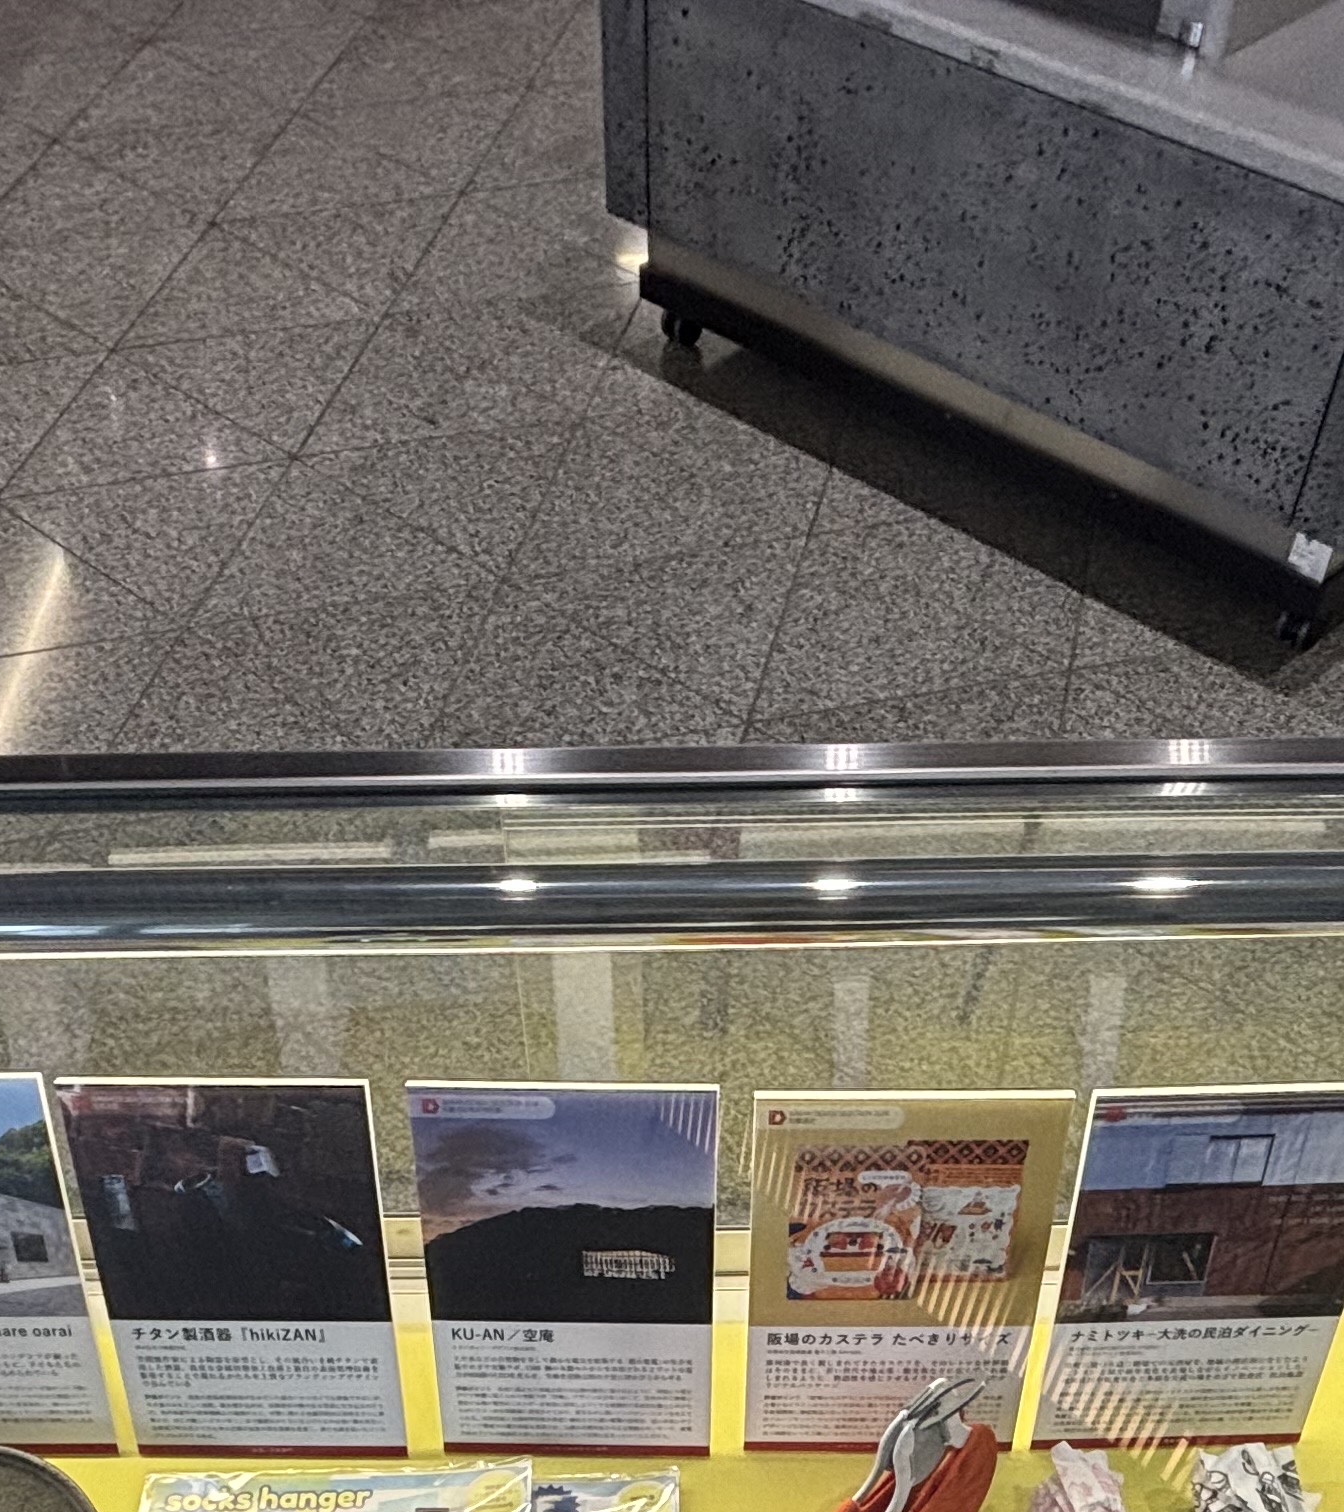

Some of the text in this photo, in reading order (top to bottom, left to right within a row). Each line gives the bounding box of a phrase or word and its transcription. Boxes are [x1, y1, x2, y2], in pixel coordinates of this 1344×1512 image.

[32, 1324, 72, 1338] oarai
[892, 1332, 1012, 1347] たべきりサズ
[165, 1486, 254, 1512] socks
